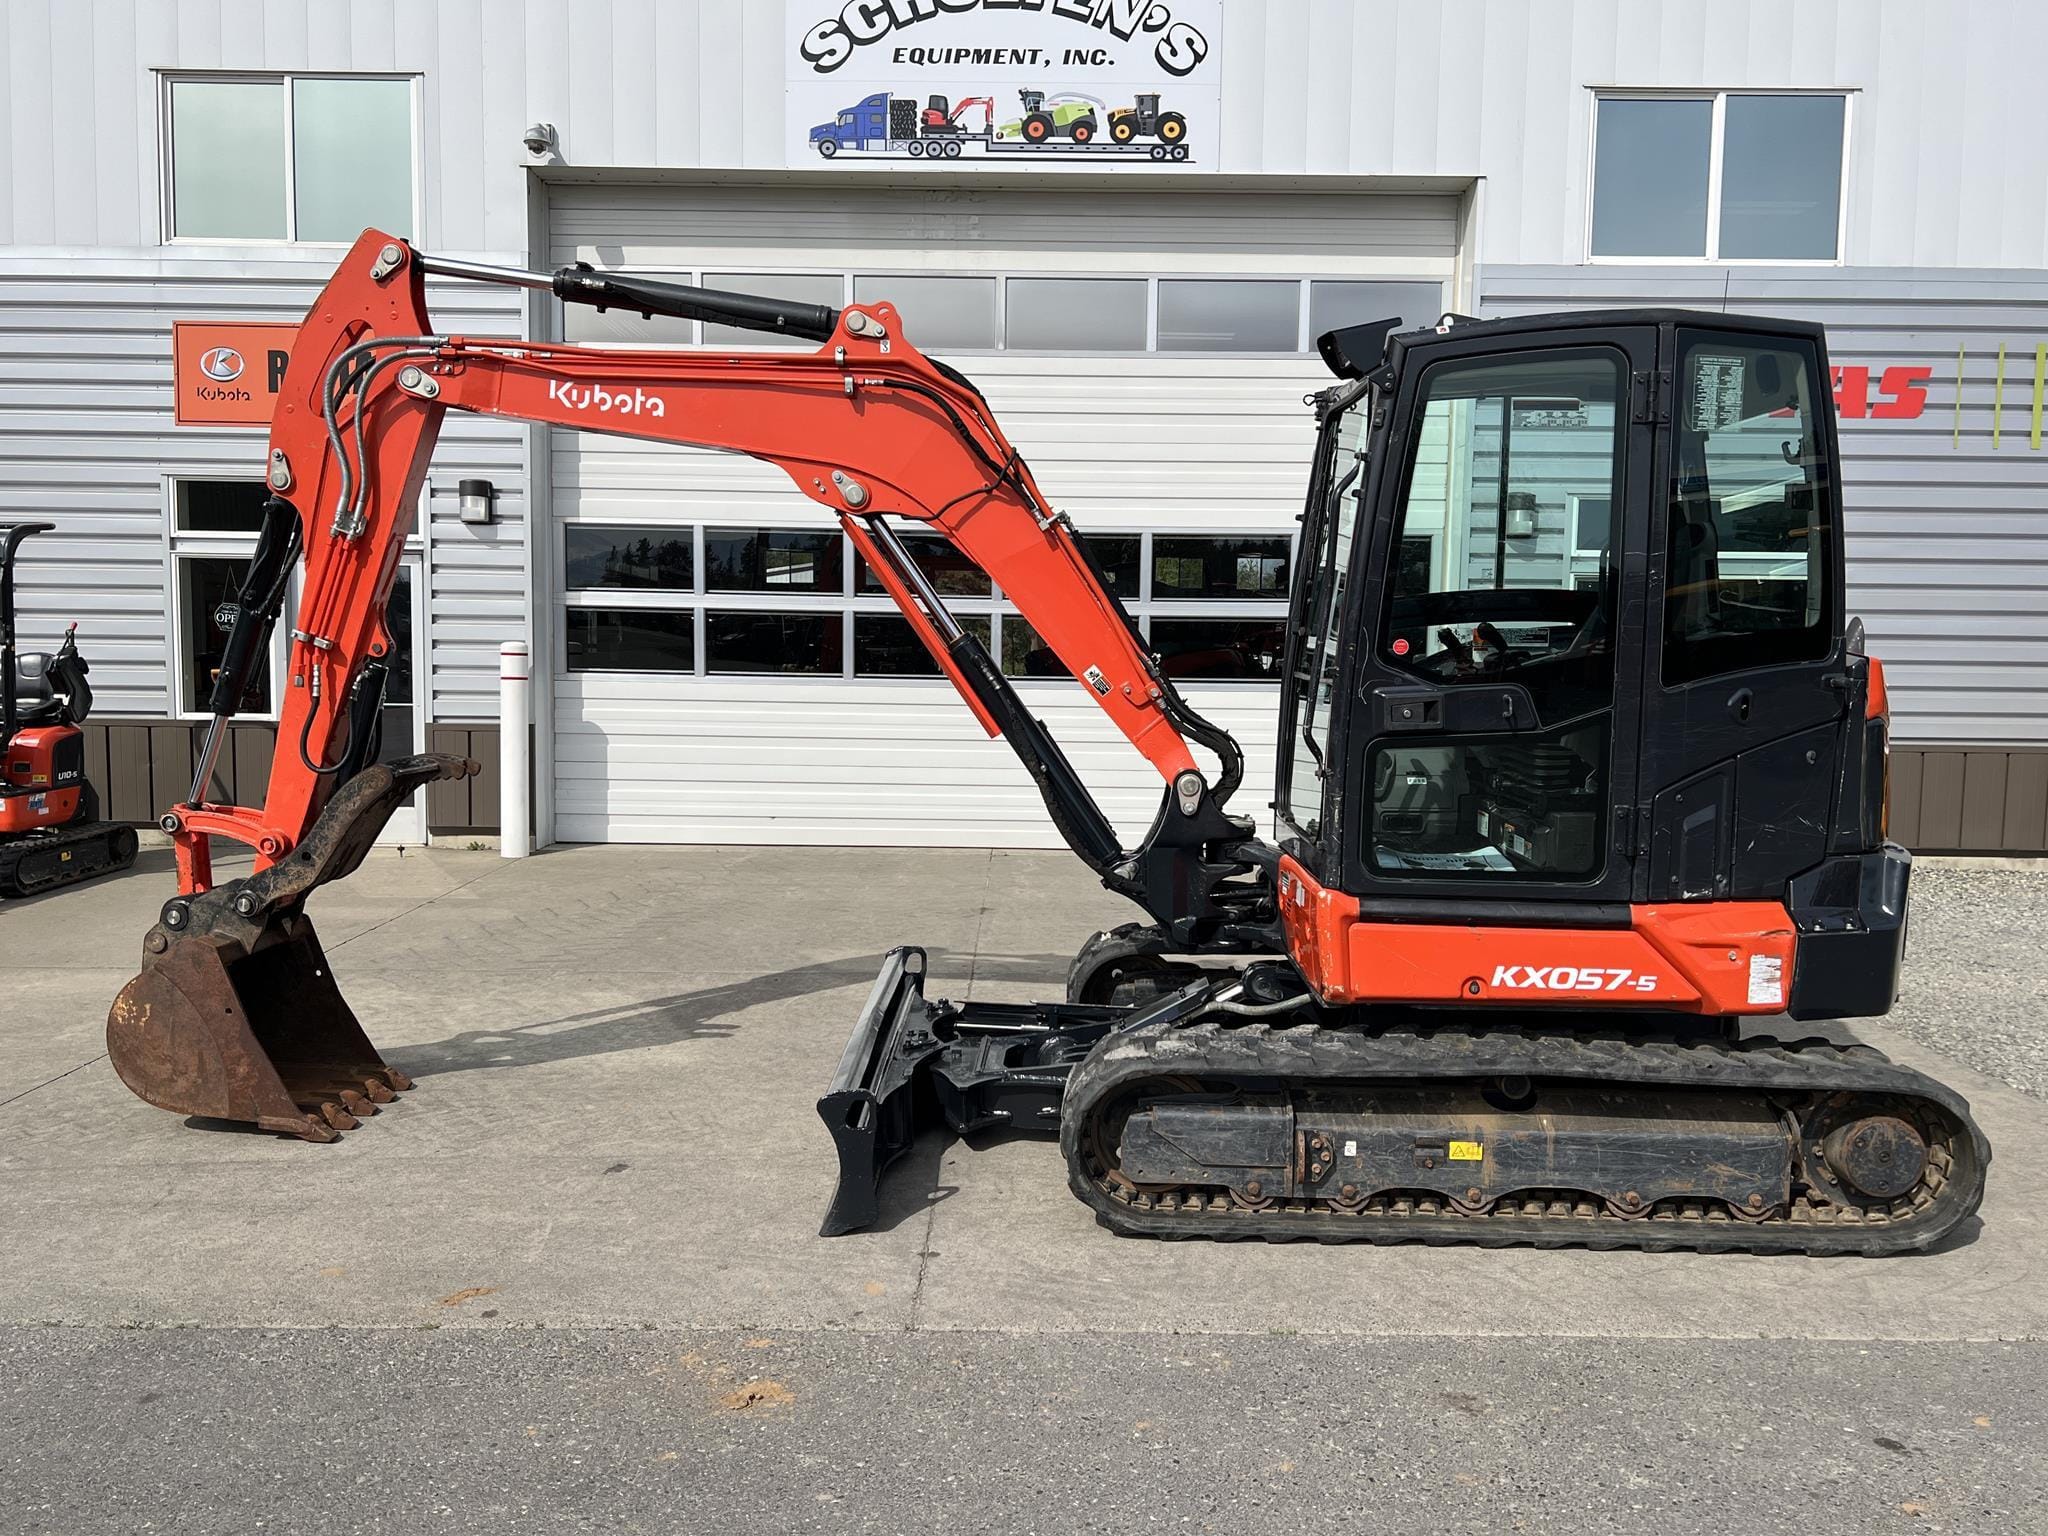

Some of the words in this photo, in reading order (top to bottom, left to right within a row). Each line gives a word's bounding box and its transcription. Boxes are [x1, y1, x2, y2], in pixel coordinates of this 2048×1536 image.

[892, 47, 1051, 68] EQUIPMENT,
[1062, 48, 1116, 66] INC.
[267, 349, 290, 393] R
[197, 386, 251, 401] Kubota
[549, 379, 665, 417] Kubota
[216, 612, 238, 624] OPE
[1491, 965, 1658, 991] KX057-5
